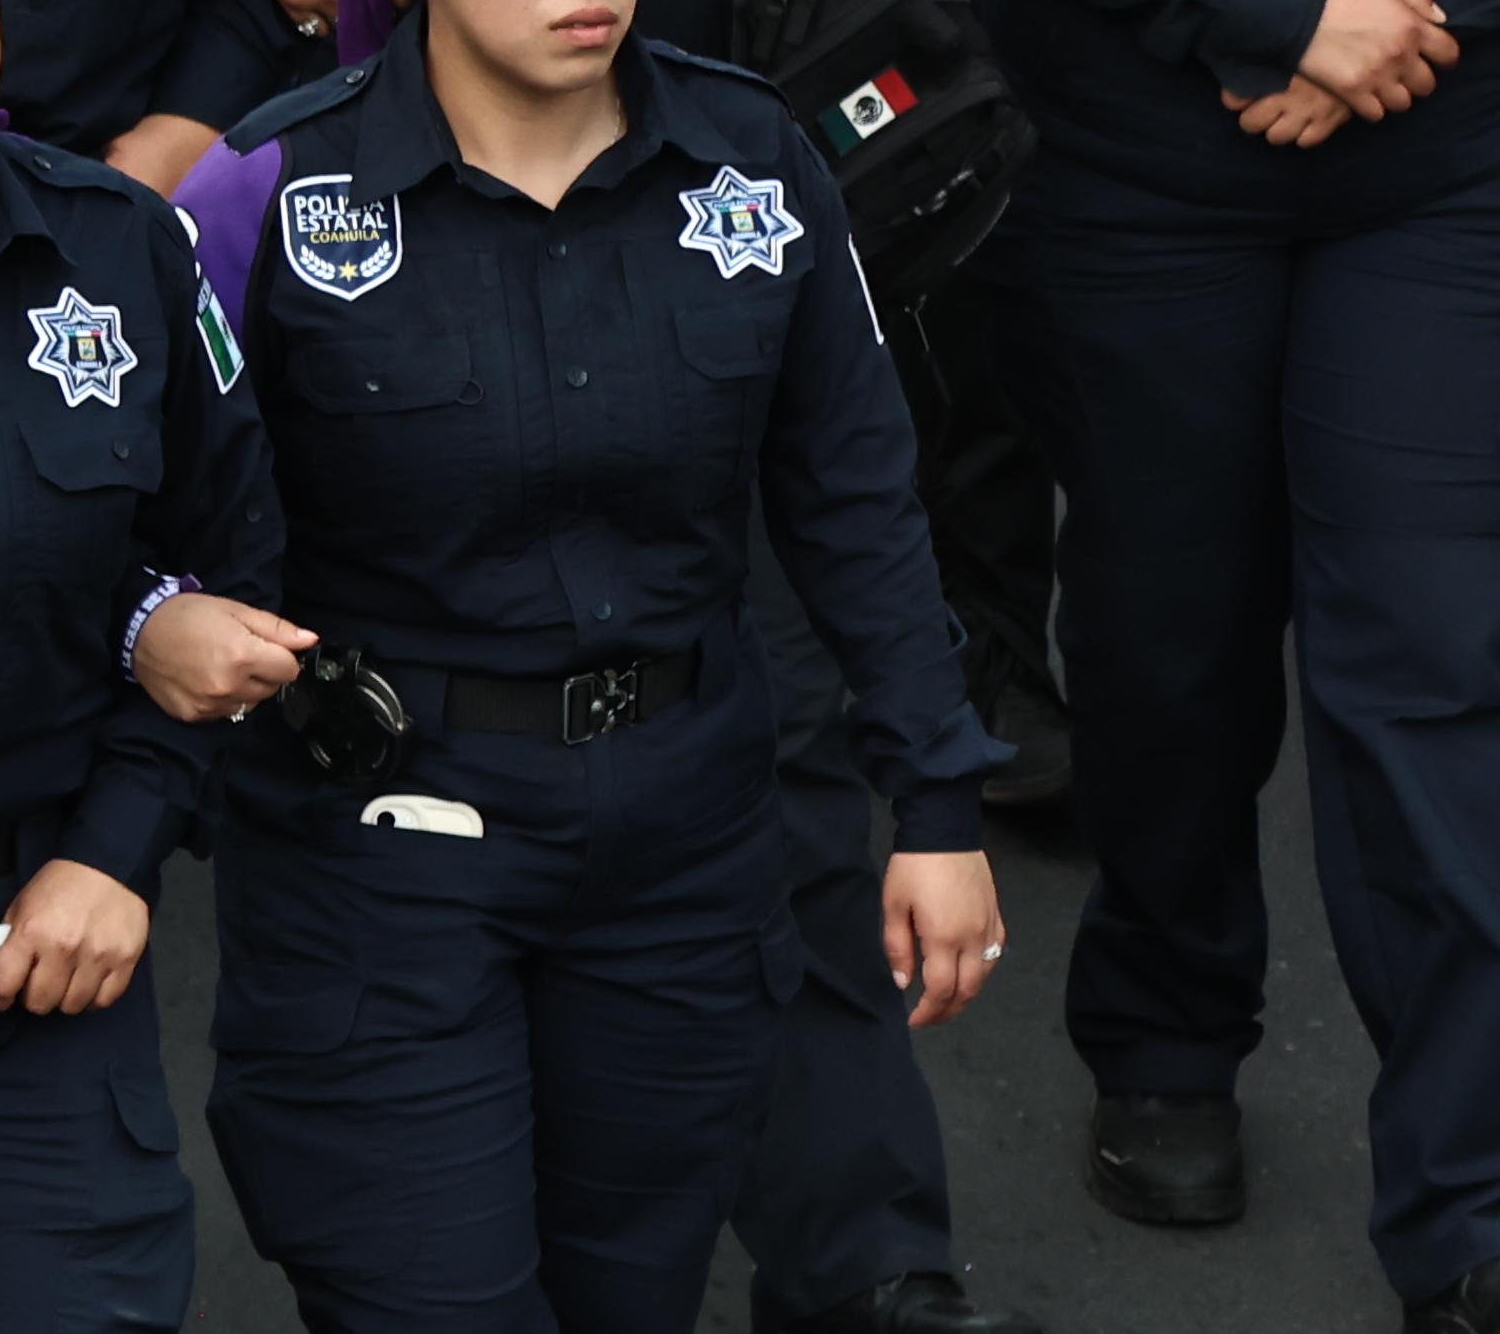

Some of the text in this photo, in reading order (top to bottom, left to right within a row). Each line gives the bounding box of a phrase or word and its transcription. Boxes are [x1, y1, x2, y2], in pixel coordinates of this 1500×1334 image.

[294, 195, 384, 215] POLIA
[296, 212, 388, 232] ESTATAL
[310, 230, 380, 244] COAHUILA
